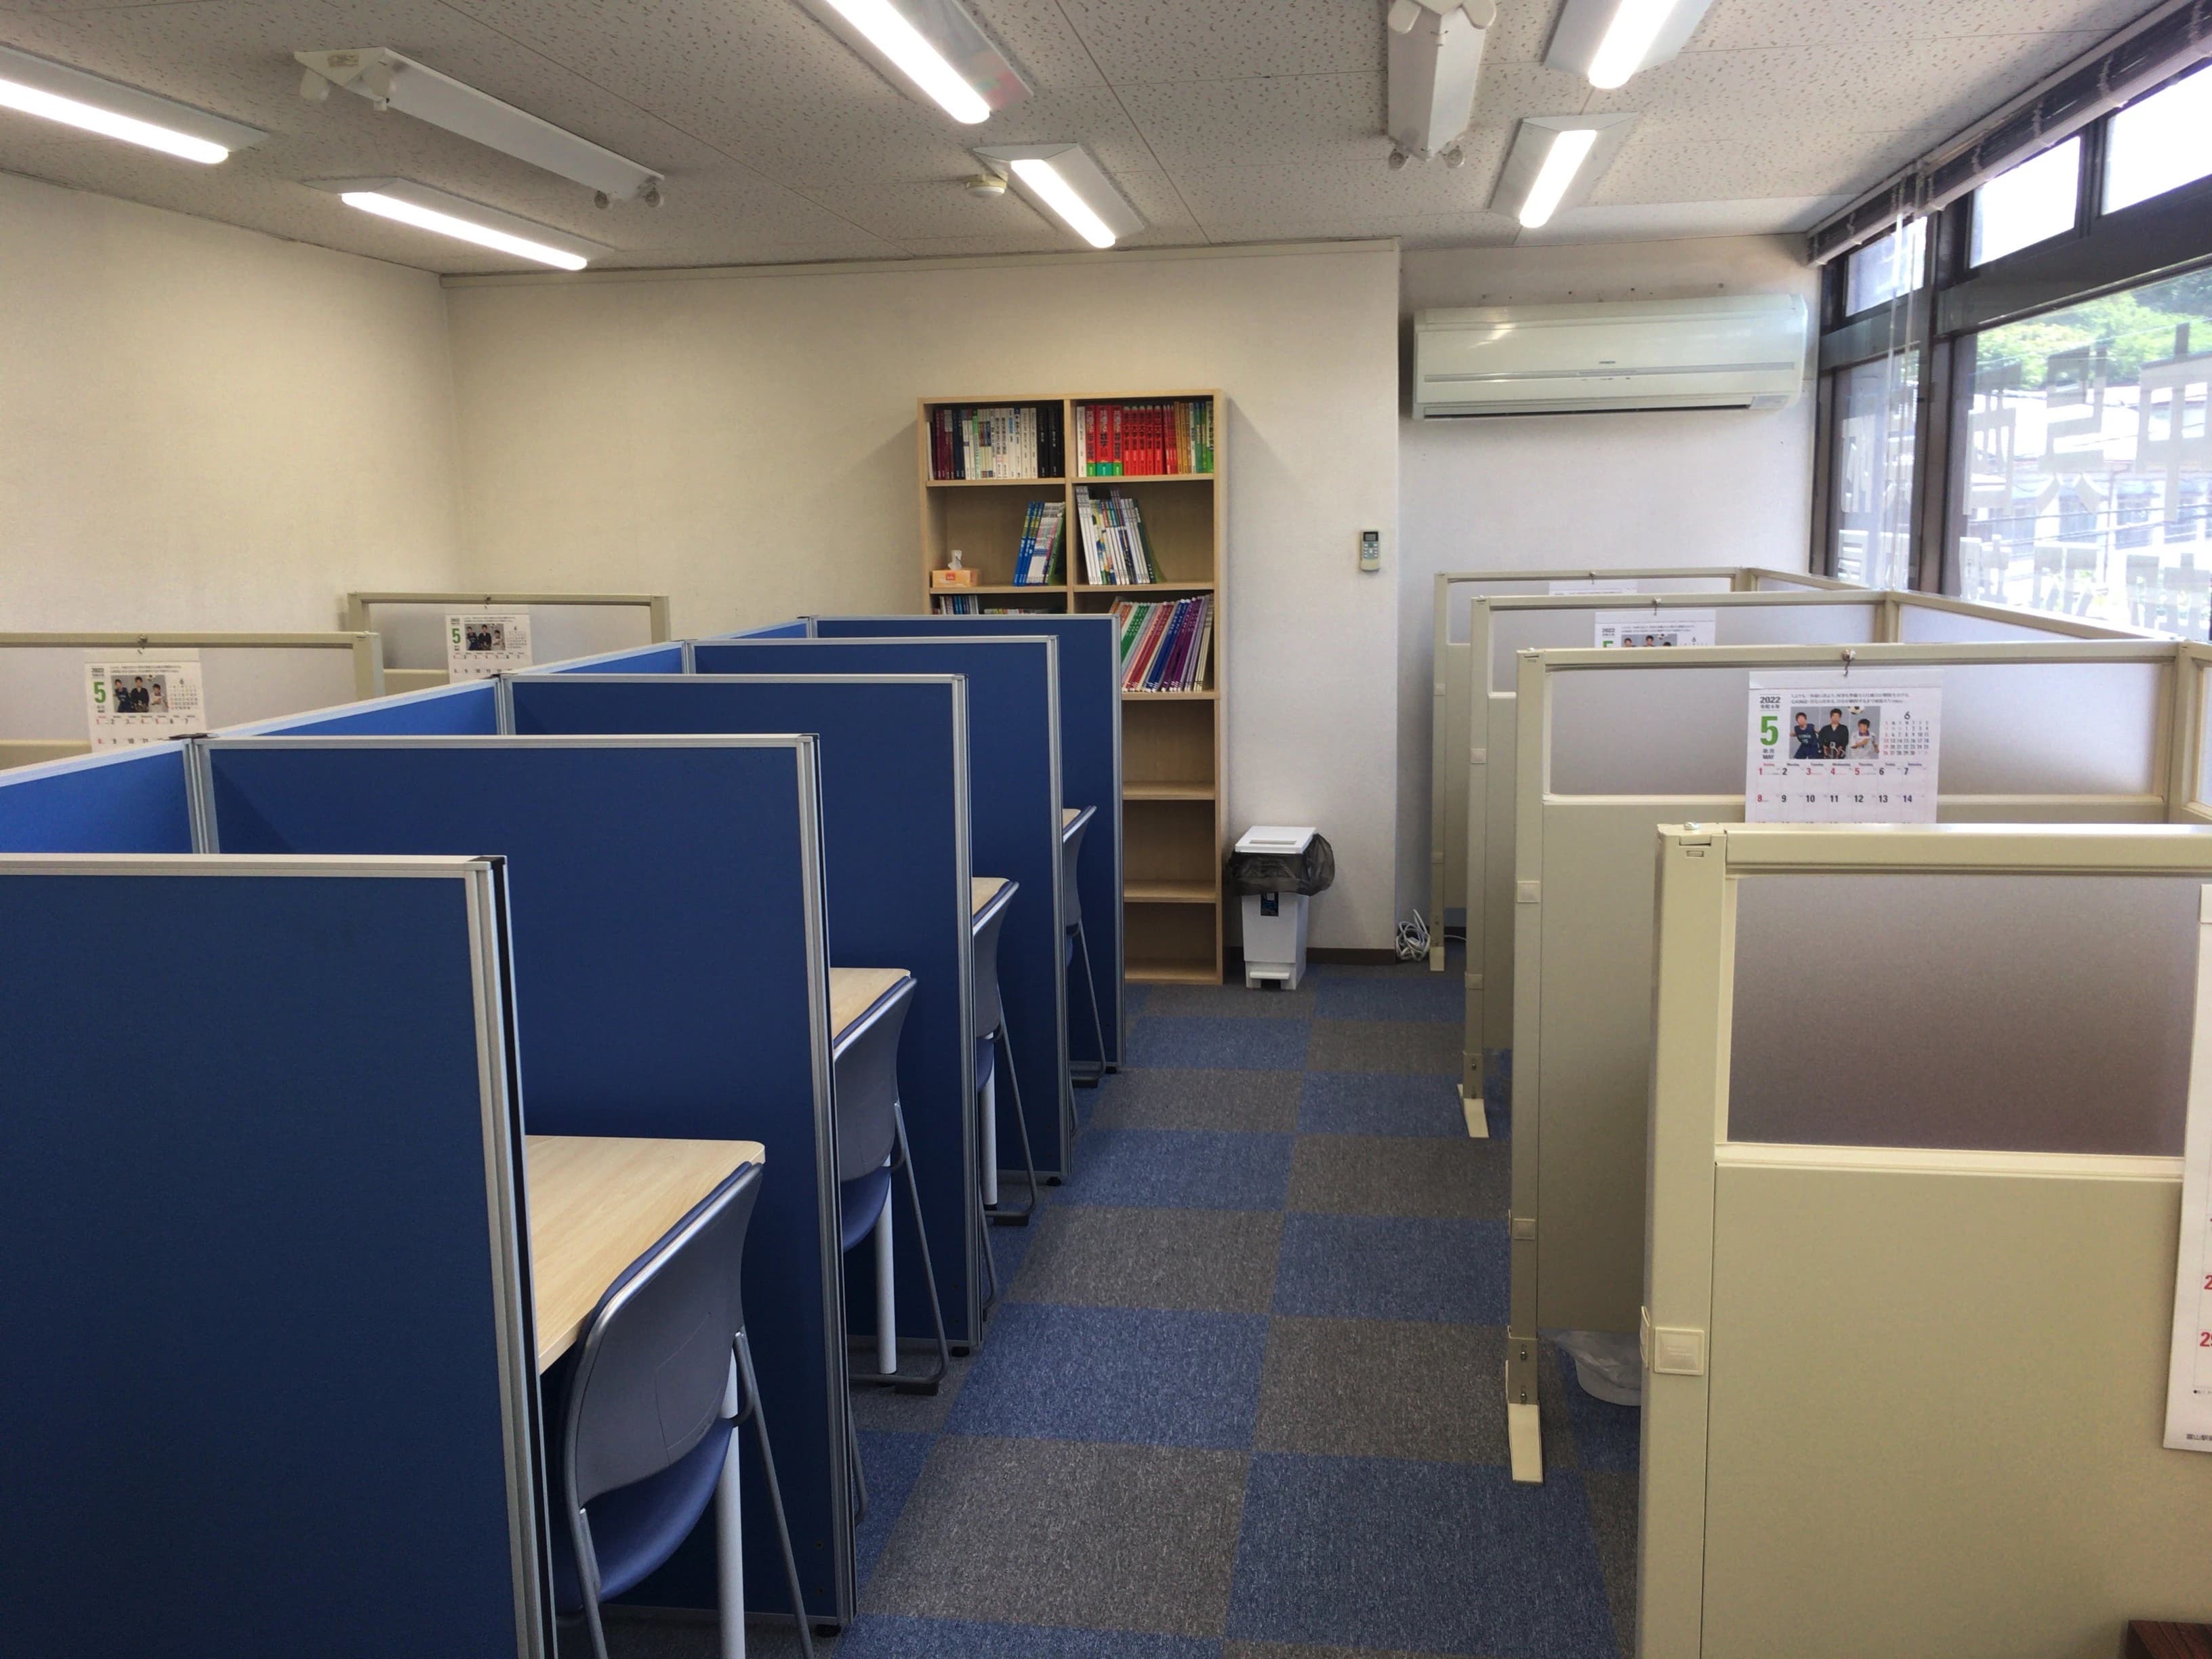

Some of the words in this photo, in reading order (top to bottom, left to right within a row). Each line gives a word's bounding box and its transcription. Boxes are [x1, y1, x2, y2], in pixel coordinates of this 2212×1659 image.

[451, 628, 461, 644] 5
[94, 682, 106, 703] 5
[1904, 711, 1911, 720] 6
[1760, 715, 1778, 746] 5
[1759, 767, 1762, 775] 1
[1782, 767, 1788, 775] 2
[1806, 767, 1811, 775] 3
[1830, 767, 1835, 775] 4
[1855, 767, 1860, 775] 5
[1879, 767, 1884, 775] 6
[1904, 767, 1908, 775] 7
[2200, 1332, 2212, 1347] 2
